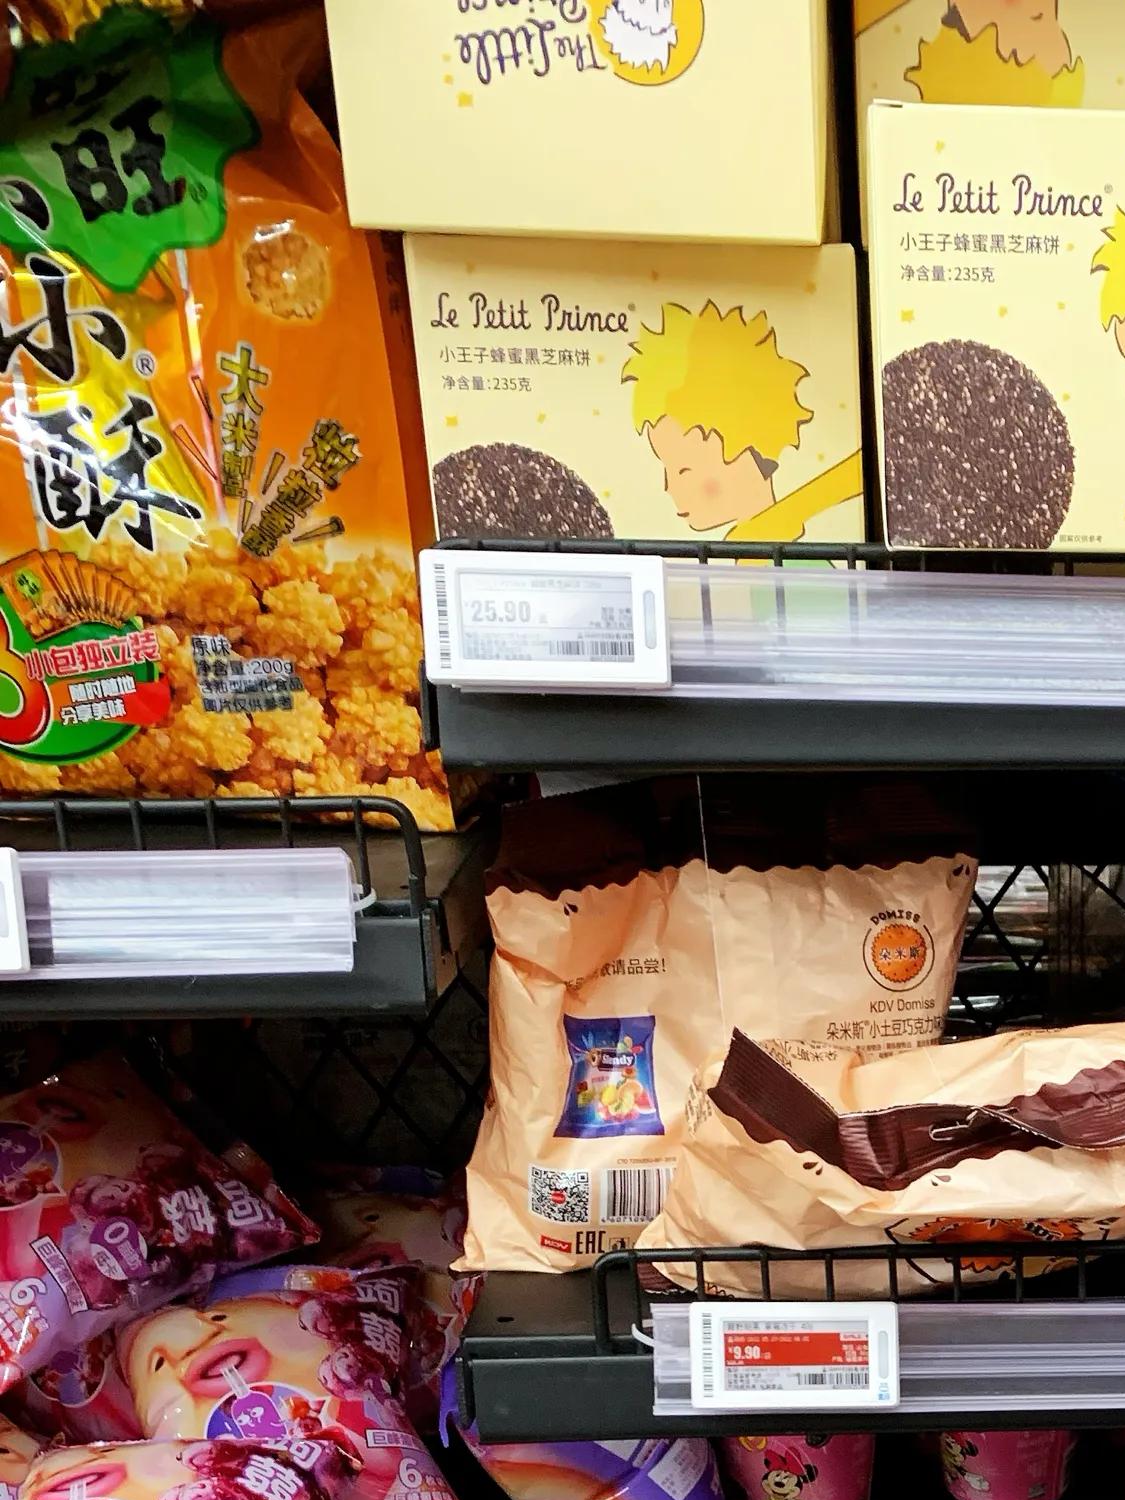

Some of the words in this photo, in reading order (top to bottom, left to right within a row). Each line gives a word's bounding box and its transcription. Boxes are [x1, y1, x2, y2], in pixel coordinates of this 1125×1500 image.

[893, 173, 925, 214] Le
[936, 172, 1001, 215] Petit
[1011, 174, 1104, 217] Prince
[900, 231, 1061, 256] 小王子蜂蜜黑芝麻饼
[900, 263, 996, 285] 净含量:235克
[431, 293, 459, 331] Le
[470, 293, 531, 331] Petit
[542, 294, 629, 333] Prince
[439, 345, 591, 369] 小王子蜂蜜黑芝麻饼
[441, 374, 532, 395] 净含量:235克
[25, 631, 161, 680] 小包独立装
[192, 635, 231, 656] 原味
[869, 998, 895, 1013] KDV
[897, 997, 936, 1012] Domiss
